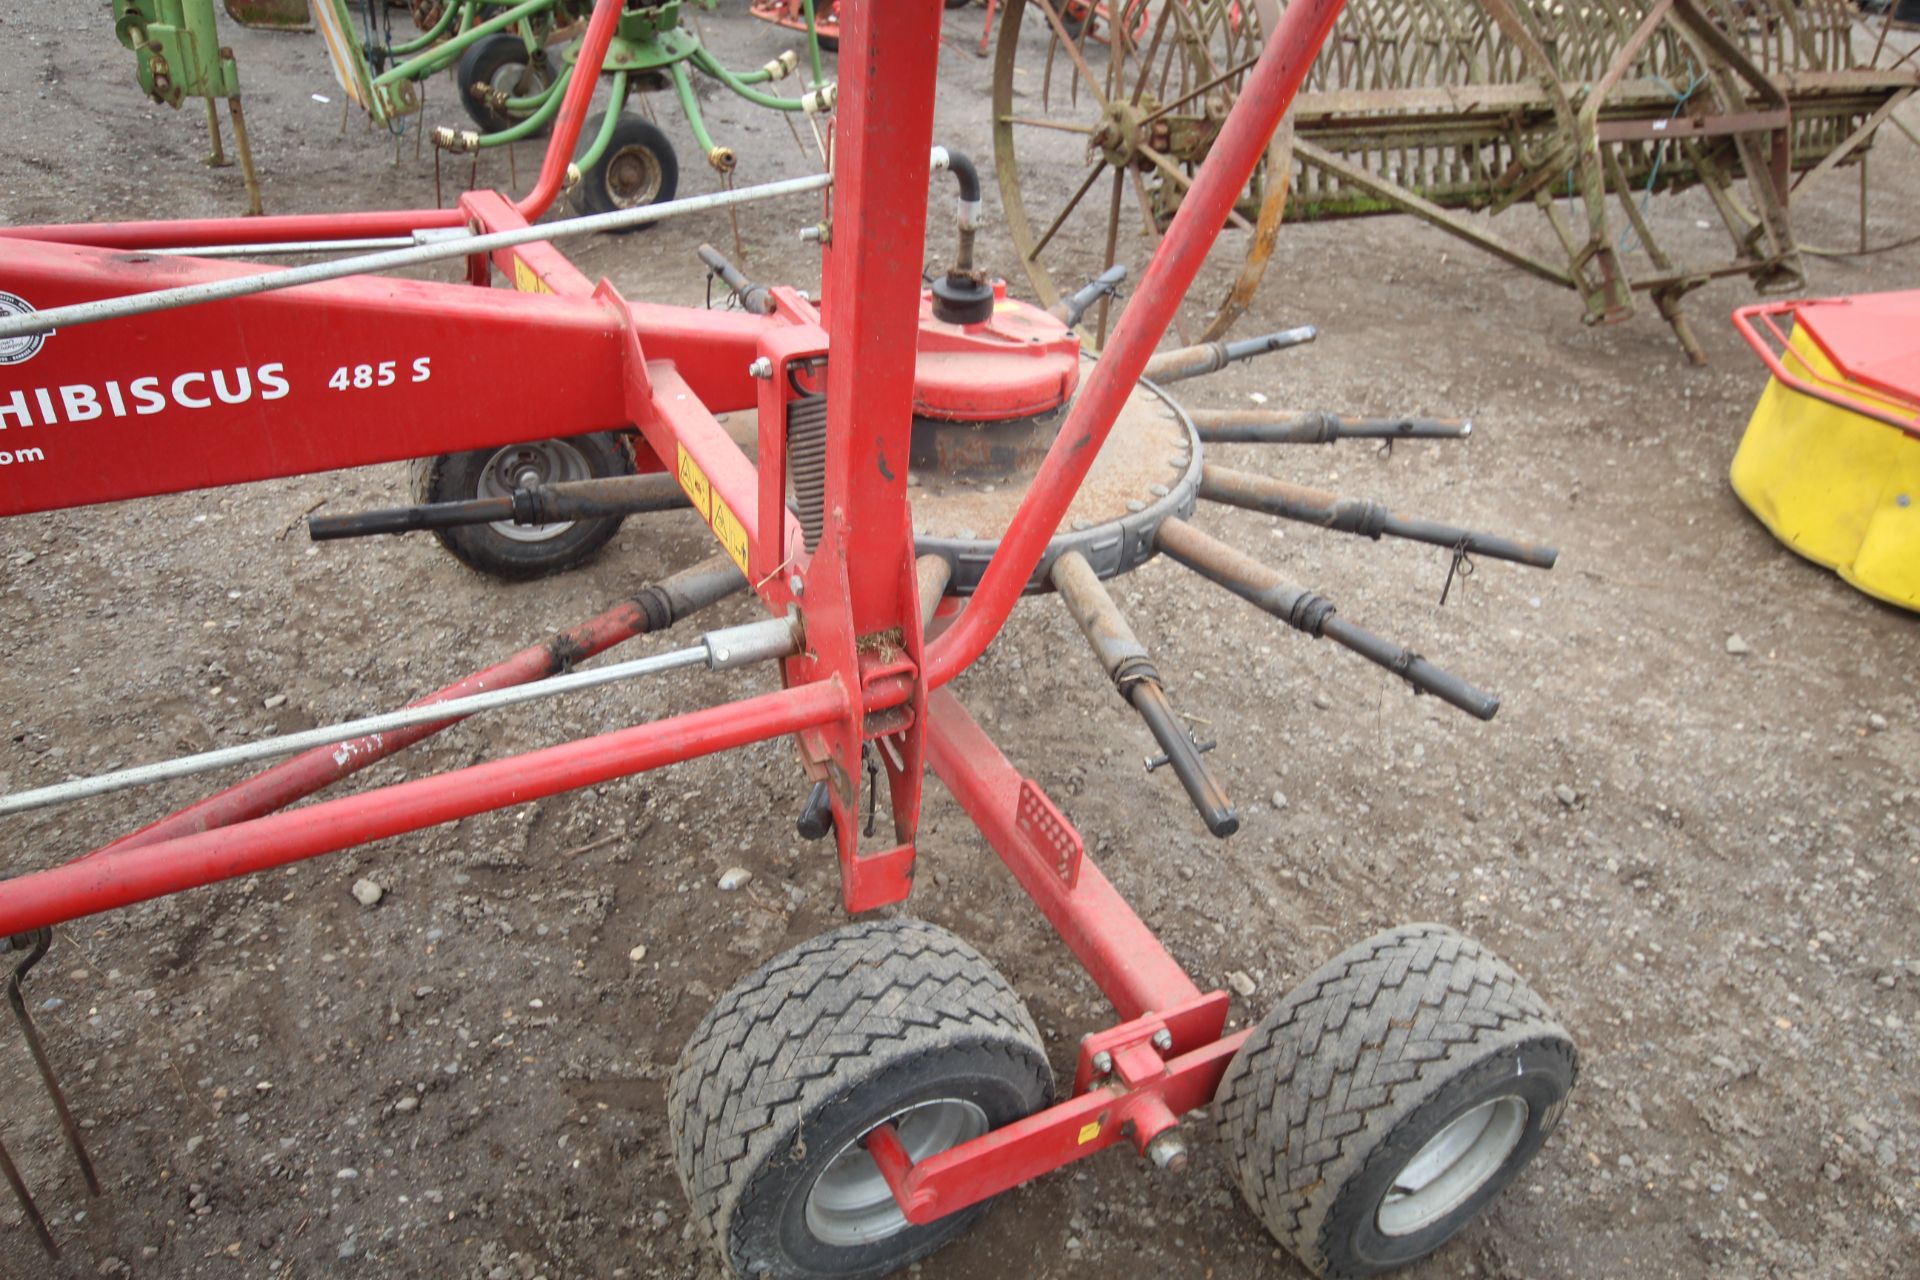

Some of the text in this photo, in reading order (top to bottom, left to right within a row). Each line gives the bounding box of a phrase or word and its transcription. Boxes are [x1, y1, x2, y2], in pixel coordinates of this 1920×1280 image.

[0, 357, 431, 430] HIBISCUS 485 S
